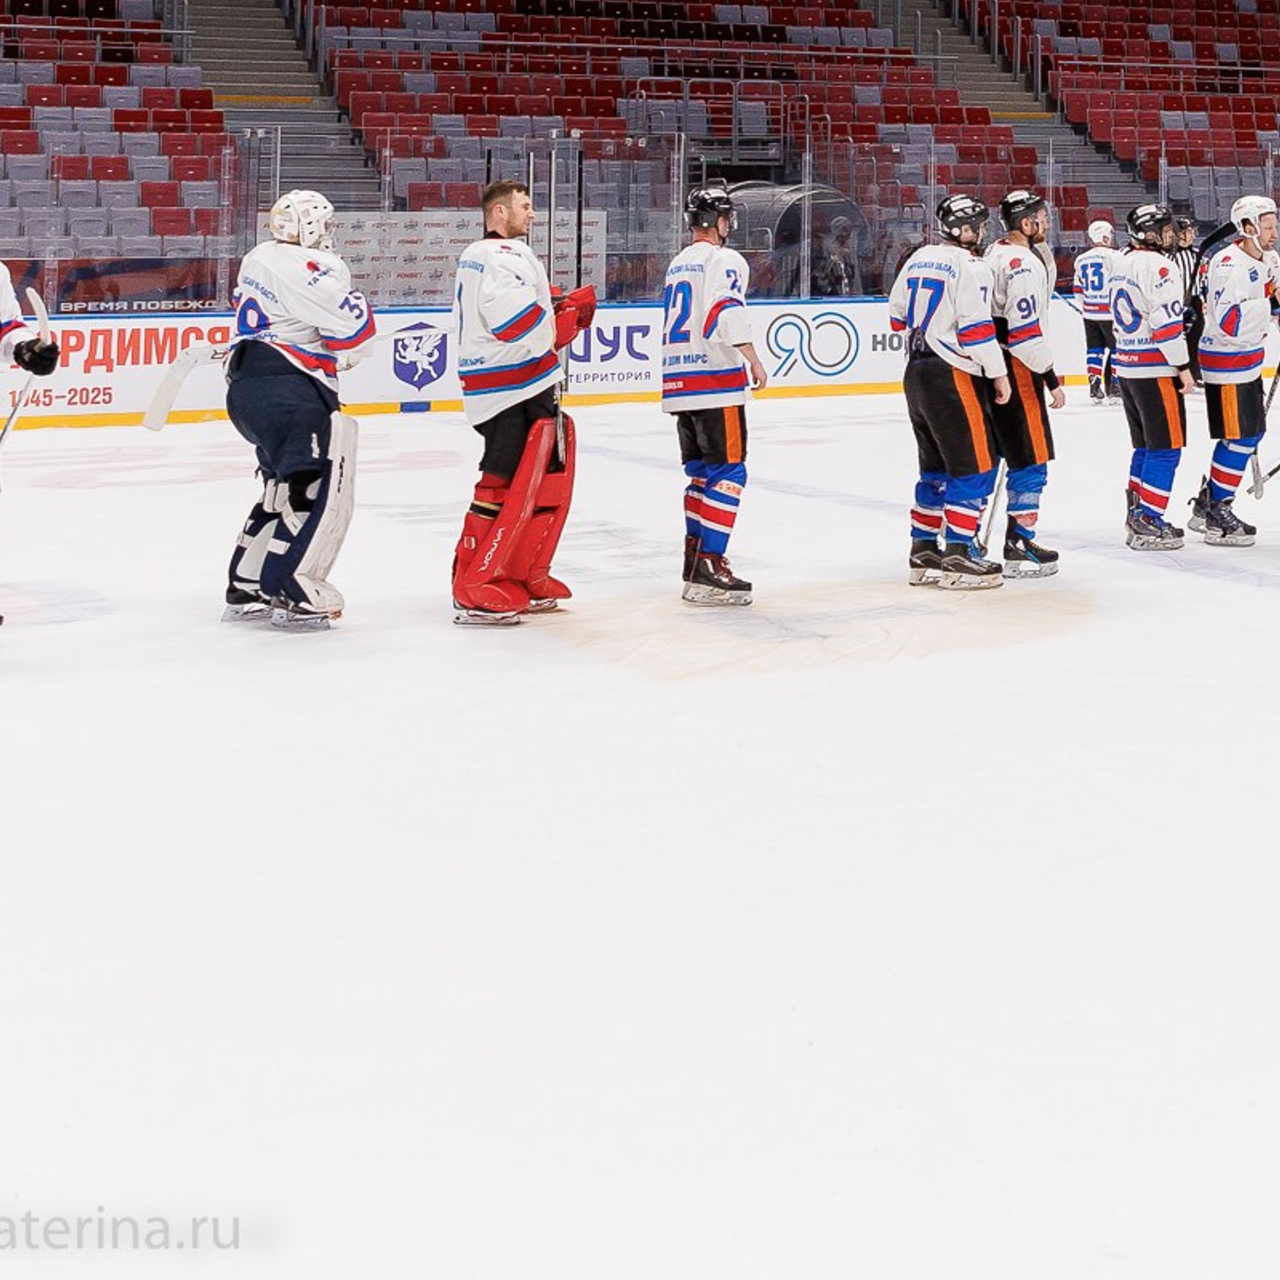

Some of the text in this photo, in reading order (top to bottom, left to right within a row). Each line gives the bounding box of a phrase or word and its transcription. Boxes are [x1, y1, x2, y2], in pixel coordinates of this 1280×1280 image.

[60, 300, 128, 312] ВРЕМЯ
[907, 277, 945, 331] 17
[1016, 294, 1037, 319] 91
[1162, 300, 1184, 319] 10
[683, 354, 708, 365] МАРС
[569, 371, 650, 383] ТЕРРИТОРИЯ
